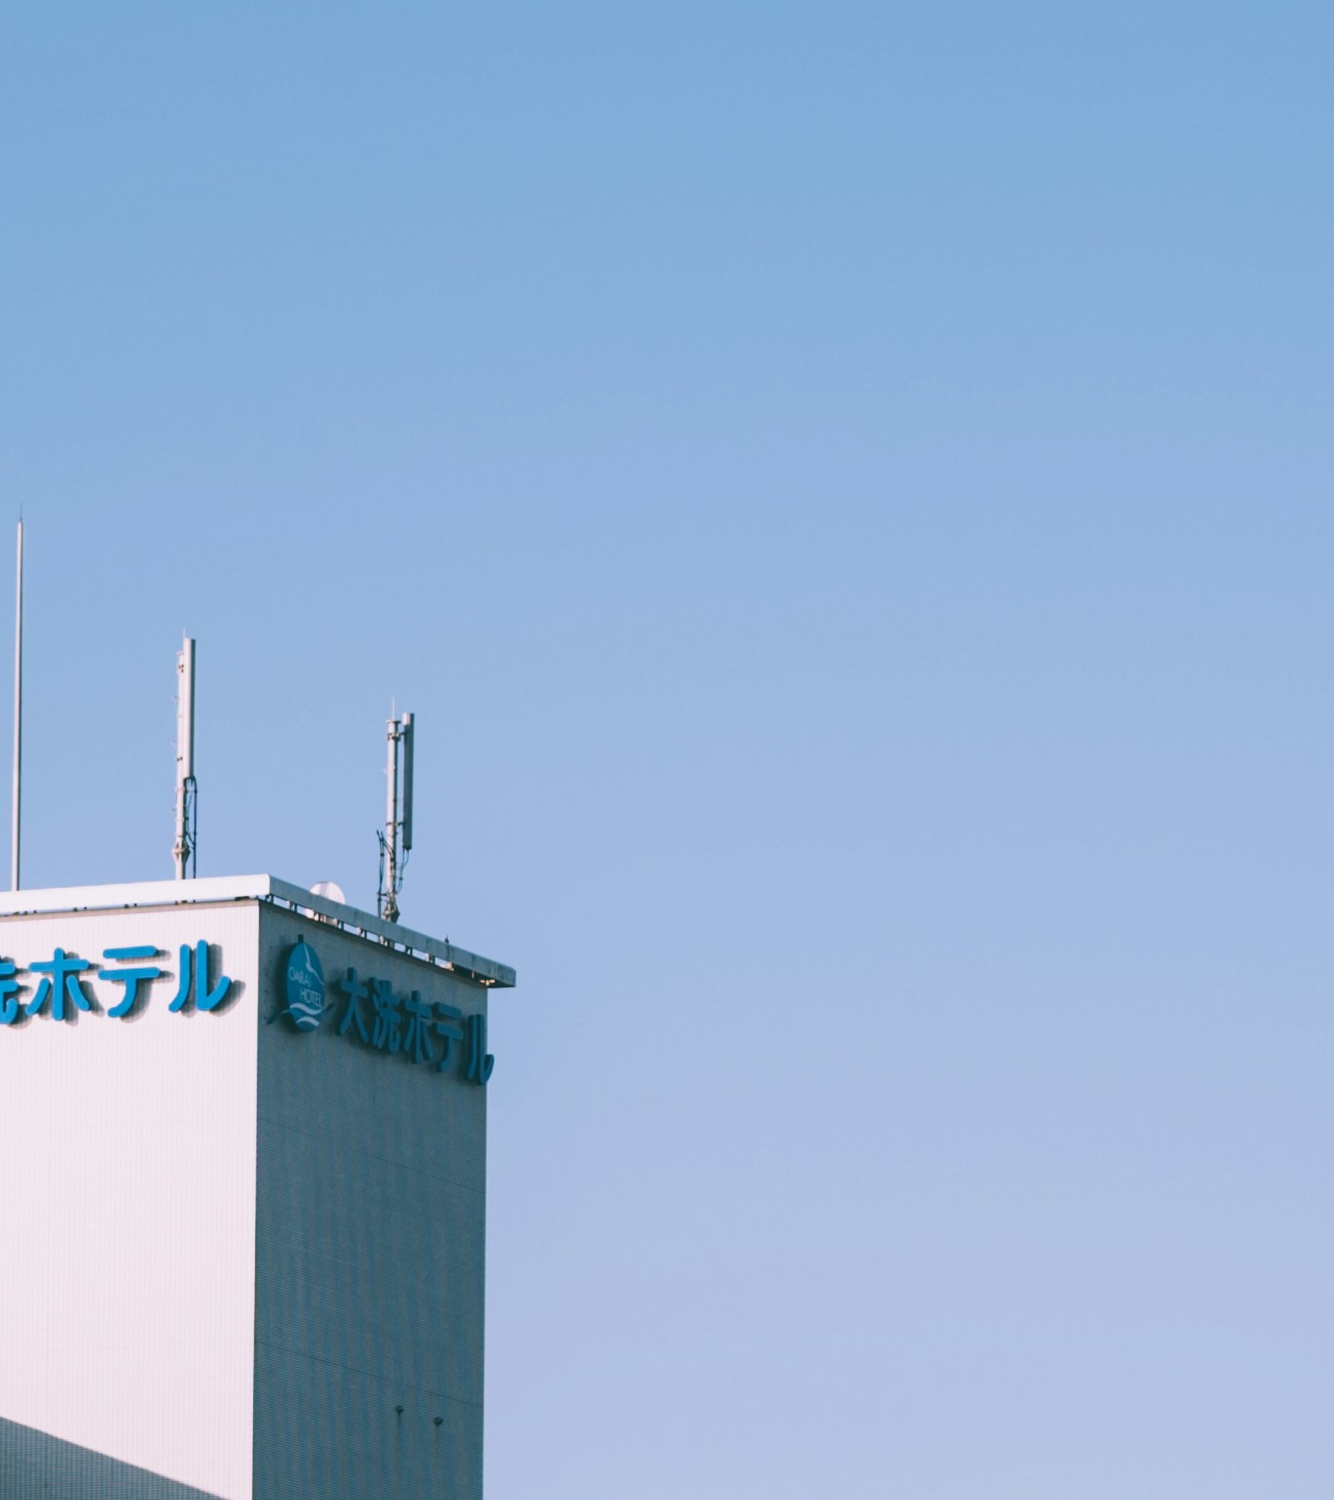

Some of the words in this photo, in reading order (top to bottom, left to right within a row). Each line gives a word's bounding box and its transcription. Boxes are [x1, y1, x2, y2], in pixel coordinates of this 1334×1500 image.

[300, 987, 323, 1008] HOTEL
[335, 966, 495, 1085] 大洗ホテル
